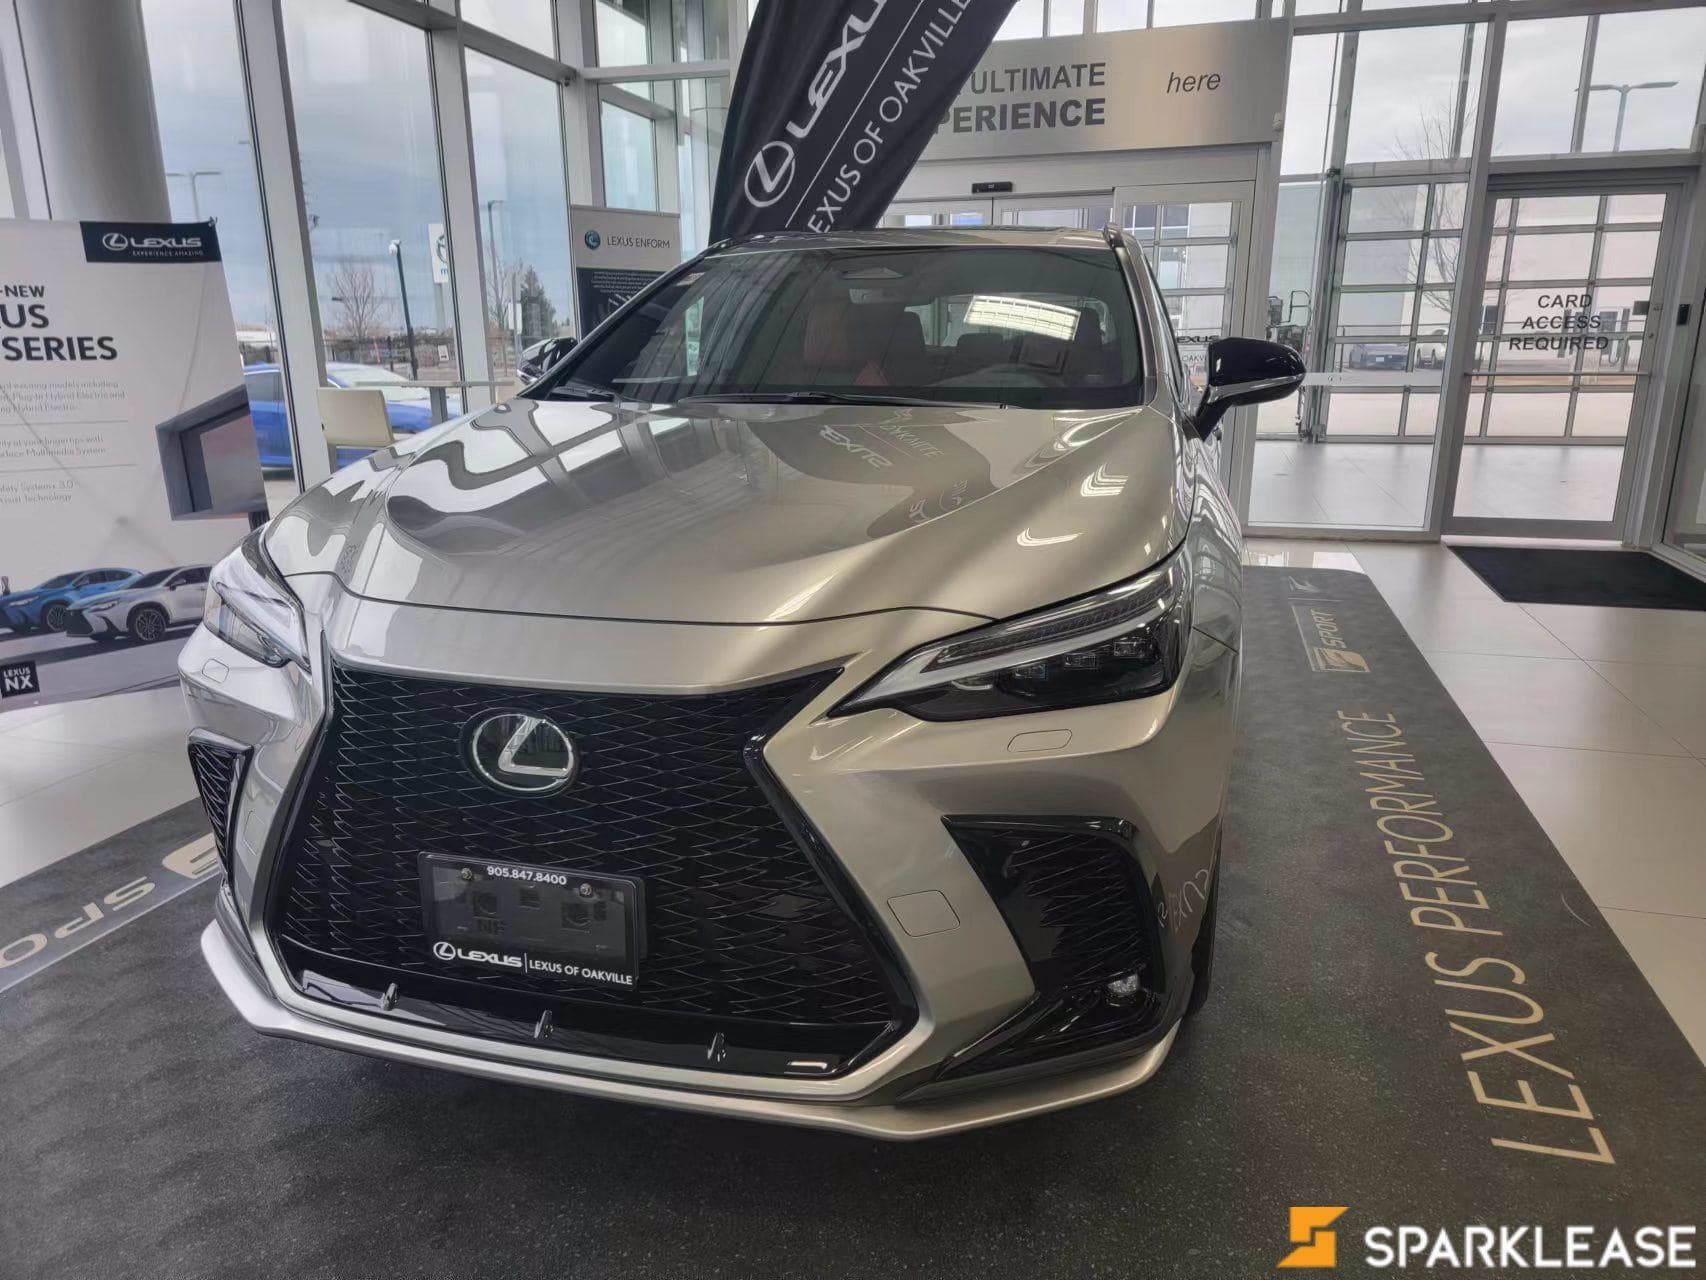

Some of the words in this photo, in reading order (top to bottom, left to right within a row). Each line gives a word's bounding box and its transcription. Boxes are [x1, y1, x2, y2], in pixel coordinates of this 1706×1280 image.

[970, 62, 1106, 95] ULTIMATE
[1166, 72, 1221, 94] here
[853, 120, 883, 164] OF
[130, 237, 202, 248] LEXUS
[606, 236, 634, 247] LEXUS
[635, 238, 670, 249] ENFORM
[1537, 294, 1593, 309] CARD
[1521, 315, 1601, 330] ACCESS
[2, 336, 118, 361] SERIES
[1509, 335, 1609, 351] REQUIRED
[1310, 608, 1347, 649] SPORT
[3, 667, 31, 678] LEXUS
[5, 674, 34, 691] NX
[1337, 709, 1504, 936] PERFORMANCE
[486, 866, 567, 886] 905.847.8400
[457, 948, 523, 968] LEXUS
[529, 959, 562, 974] LEXUS
[564, 965, 579, 977] OF
[582, 968, 633, 986] OAKVILLE
[1424, 951, 1616, 1165] LEXUS
